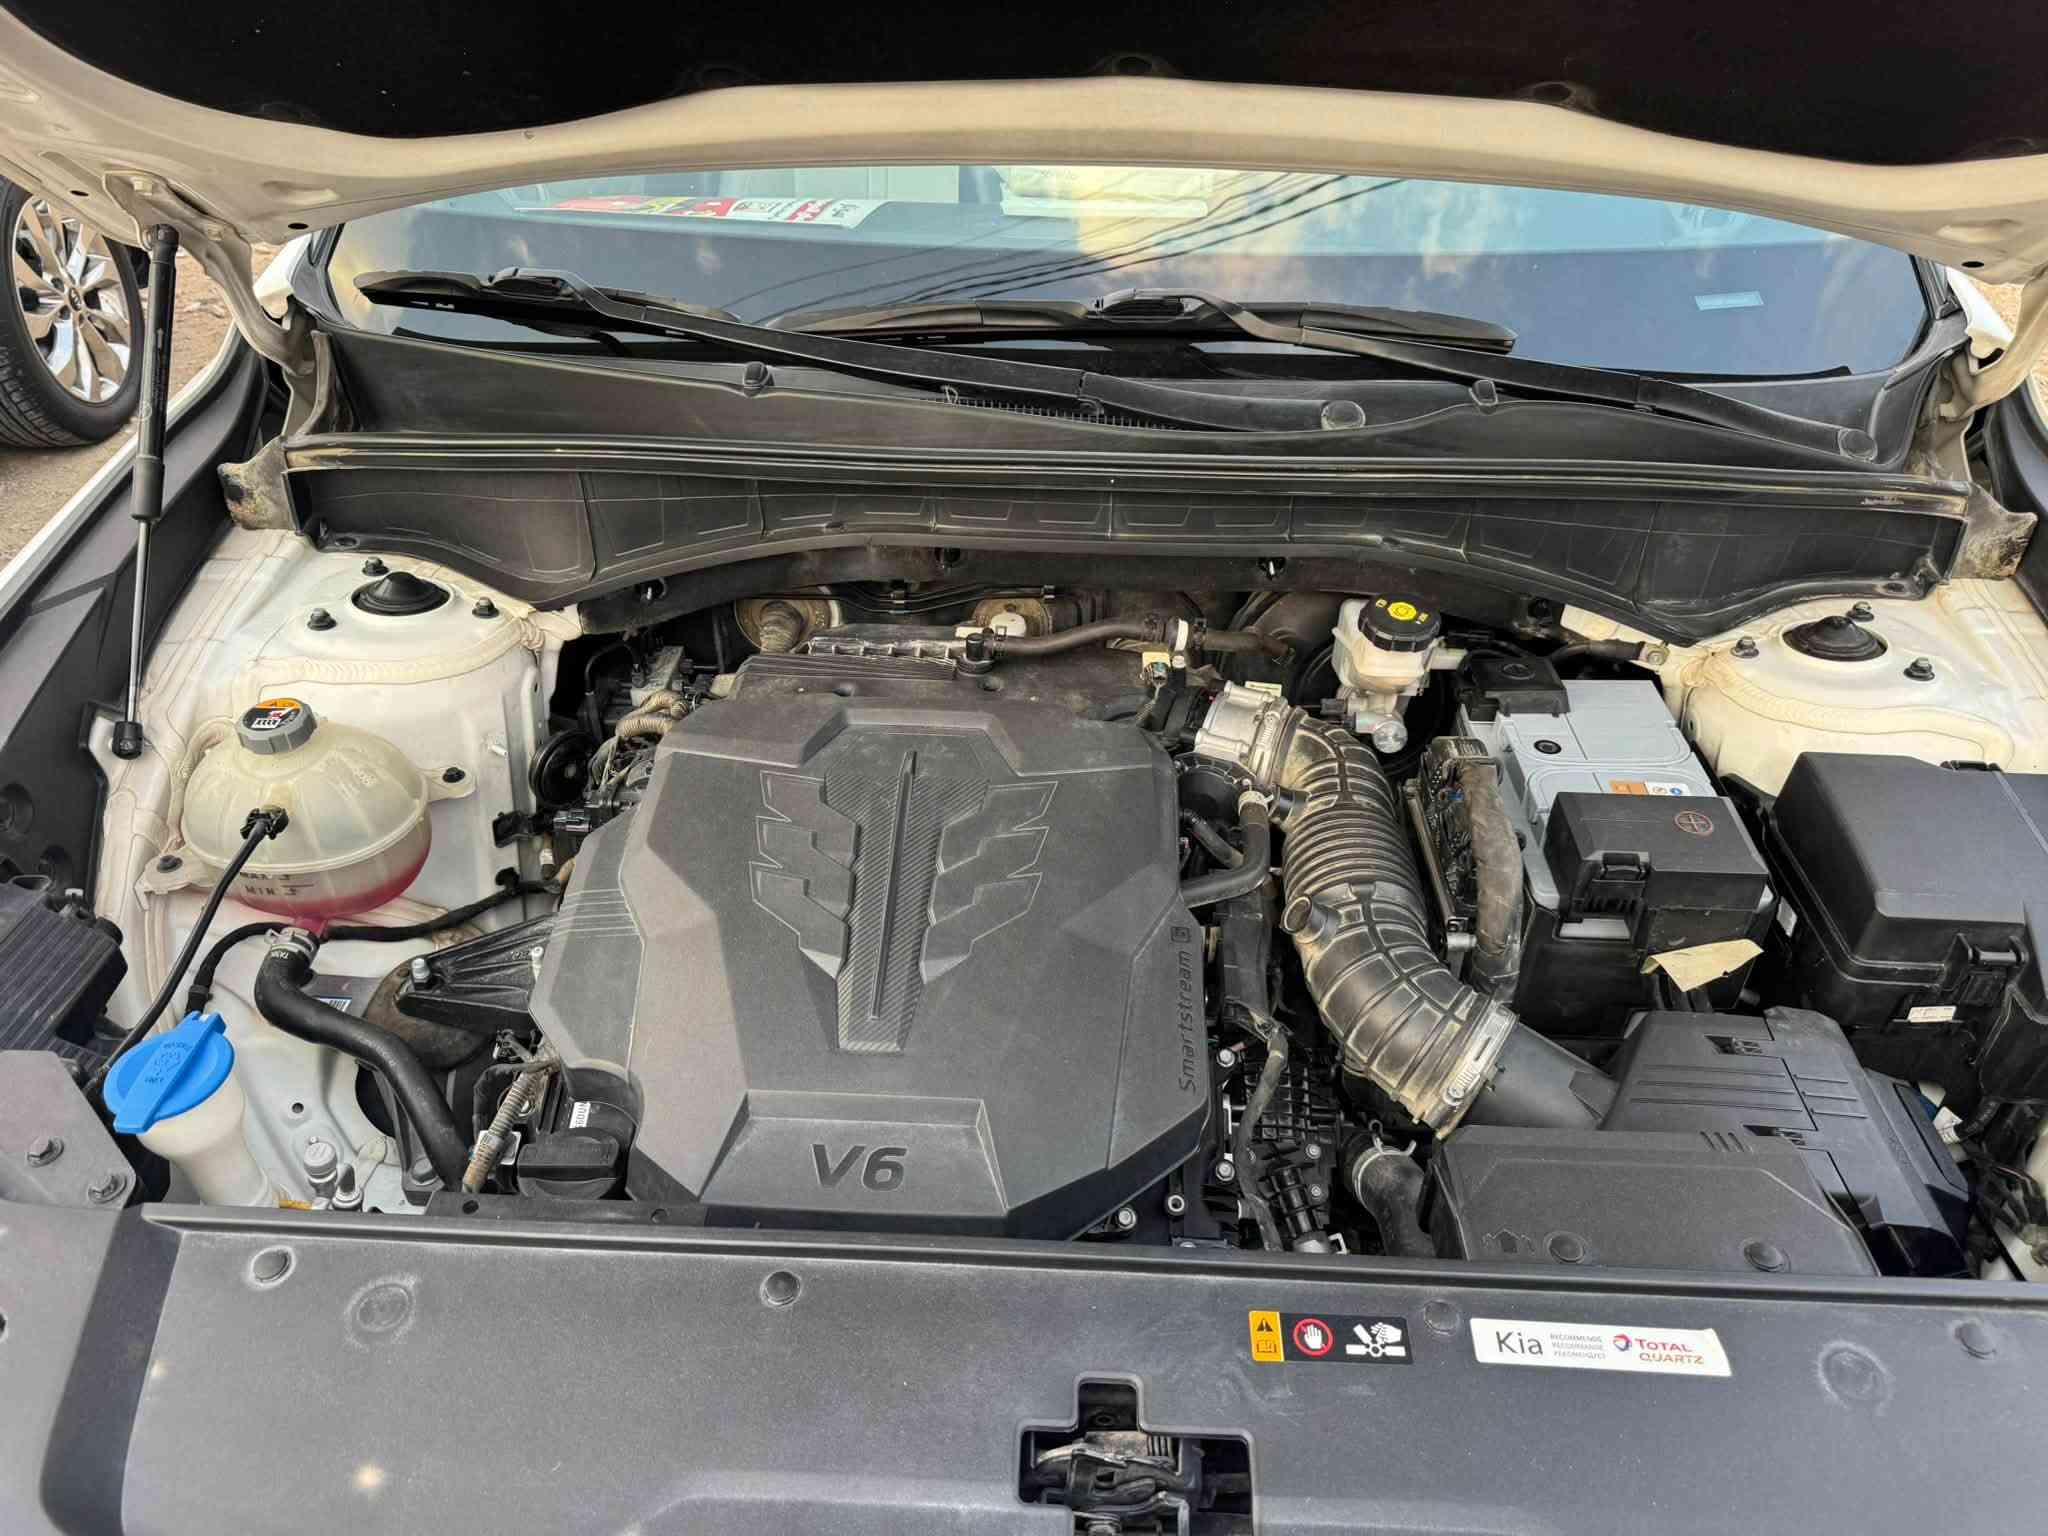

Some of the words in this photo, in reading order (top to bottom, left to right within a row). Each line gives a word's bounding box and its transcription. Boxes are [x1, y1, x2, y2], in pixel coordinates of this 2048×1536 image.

[1177, 950, 1196, 1096] Smartstream
[810, 1143, 908, 1191] V6
[1495, 1331, 1544, 1355] Kia
[1639, 1352, 1704, 1365] QUARTZ
